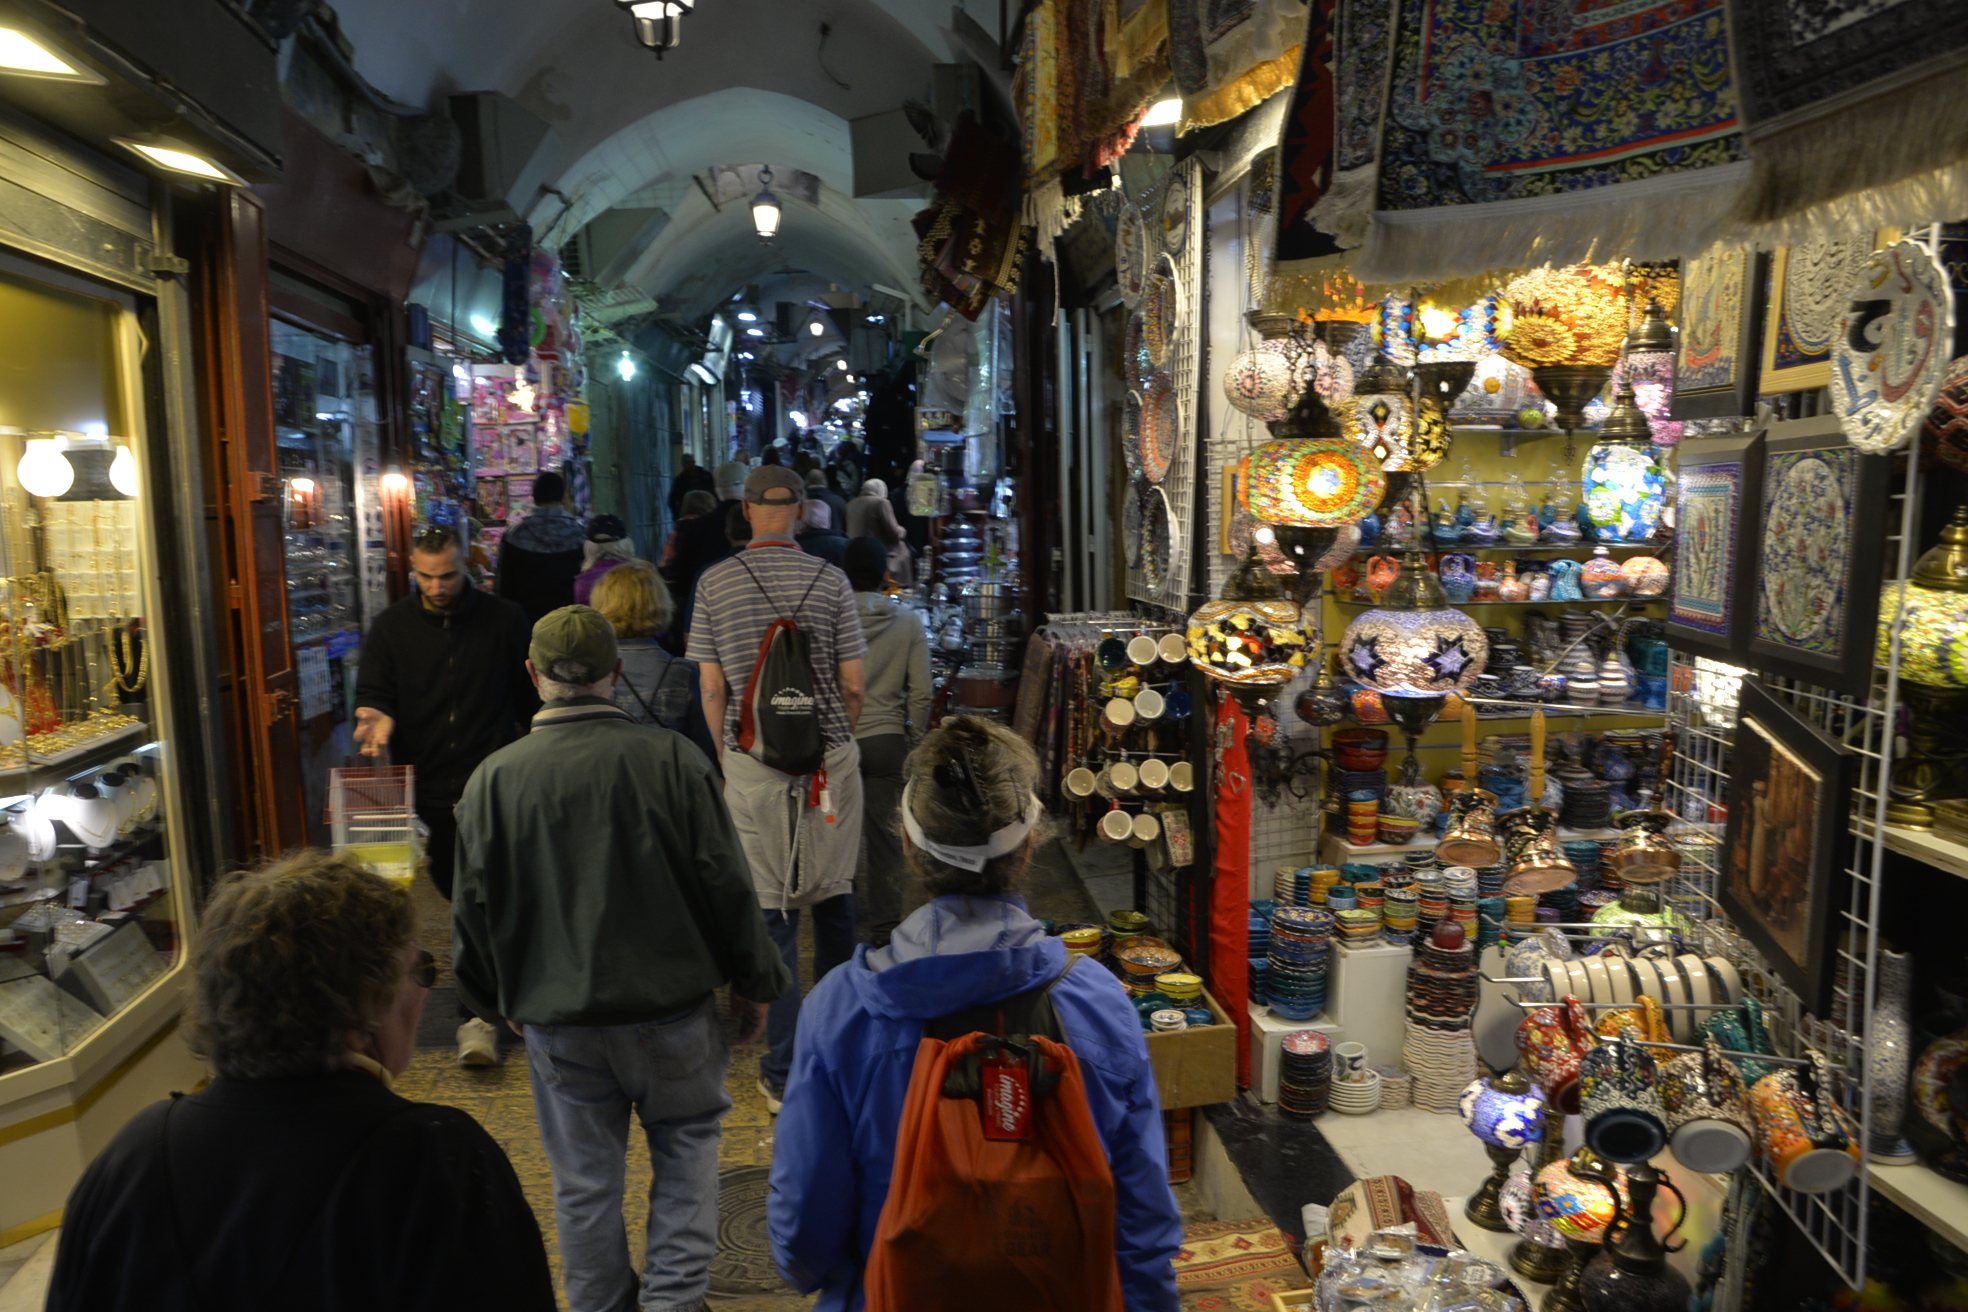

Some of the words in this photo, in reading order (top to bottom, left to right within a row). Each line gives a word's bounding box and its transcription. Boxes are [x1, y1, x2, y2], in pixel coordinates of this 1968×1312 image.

[770, 694, 814, 710] imagine
[994, 1074, 1016, 1132] imagine
[1004, 1241, 1052, 1258] GEAR
